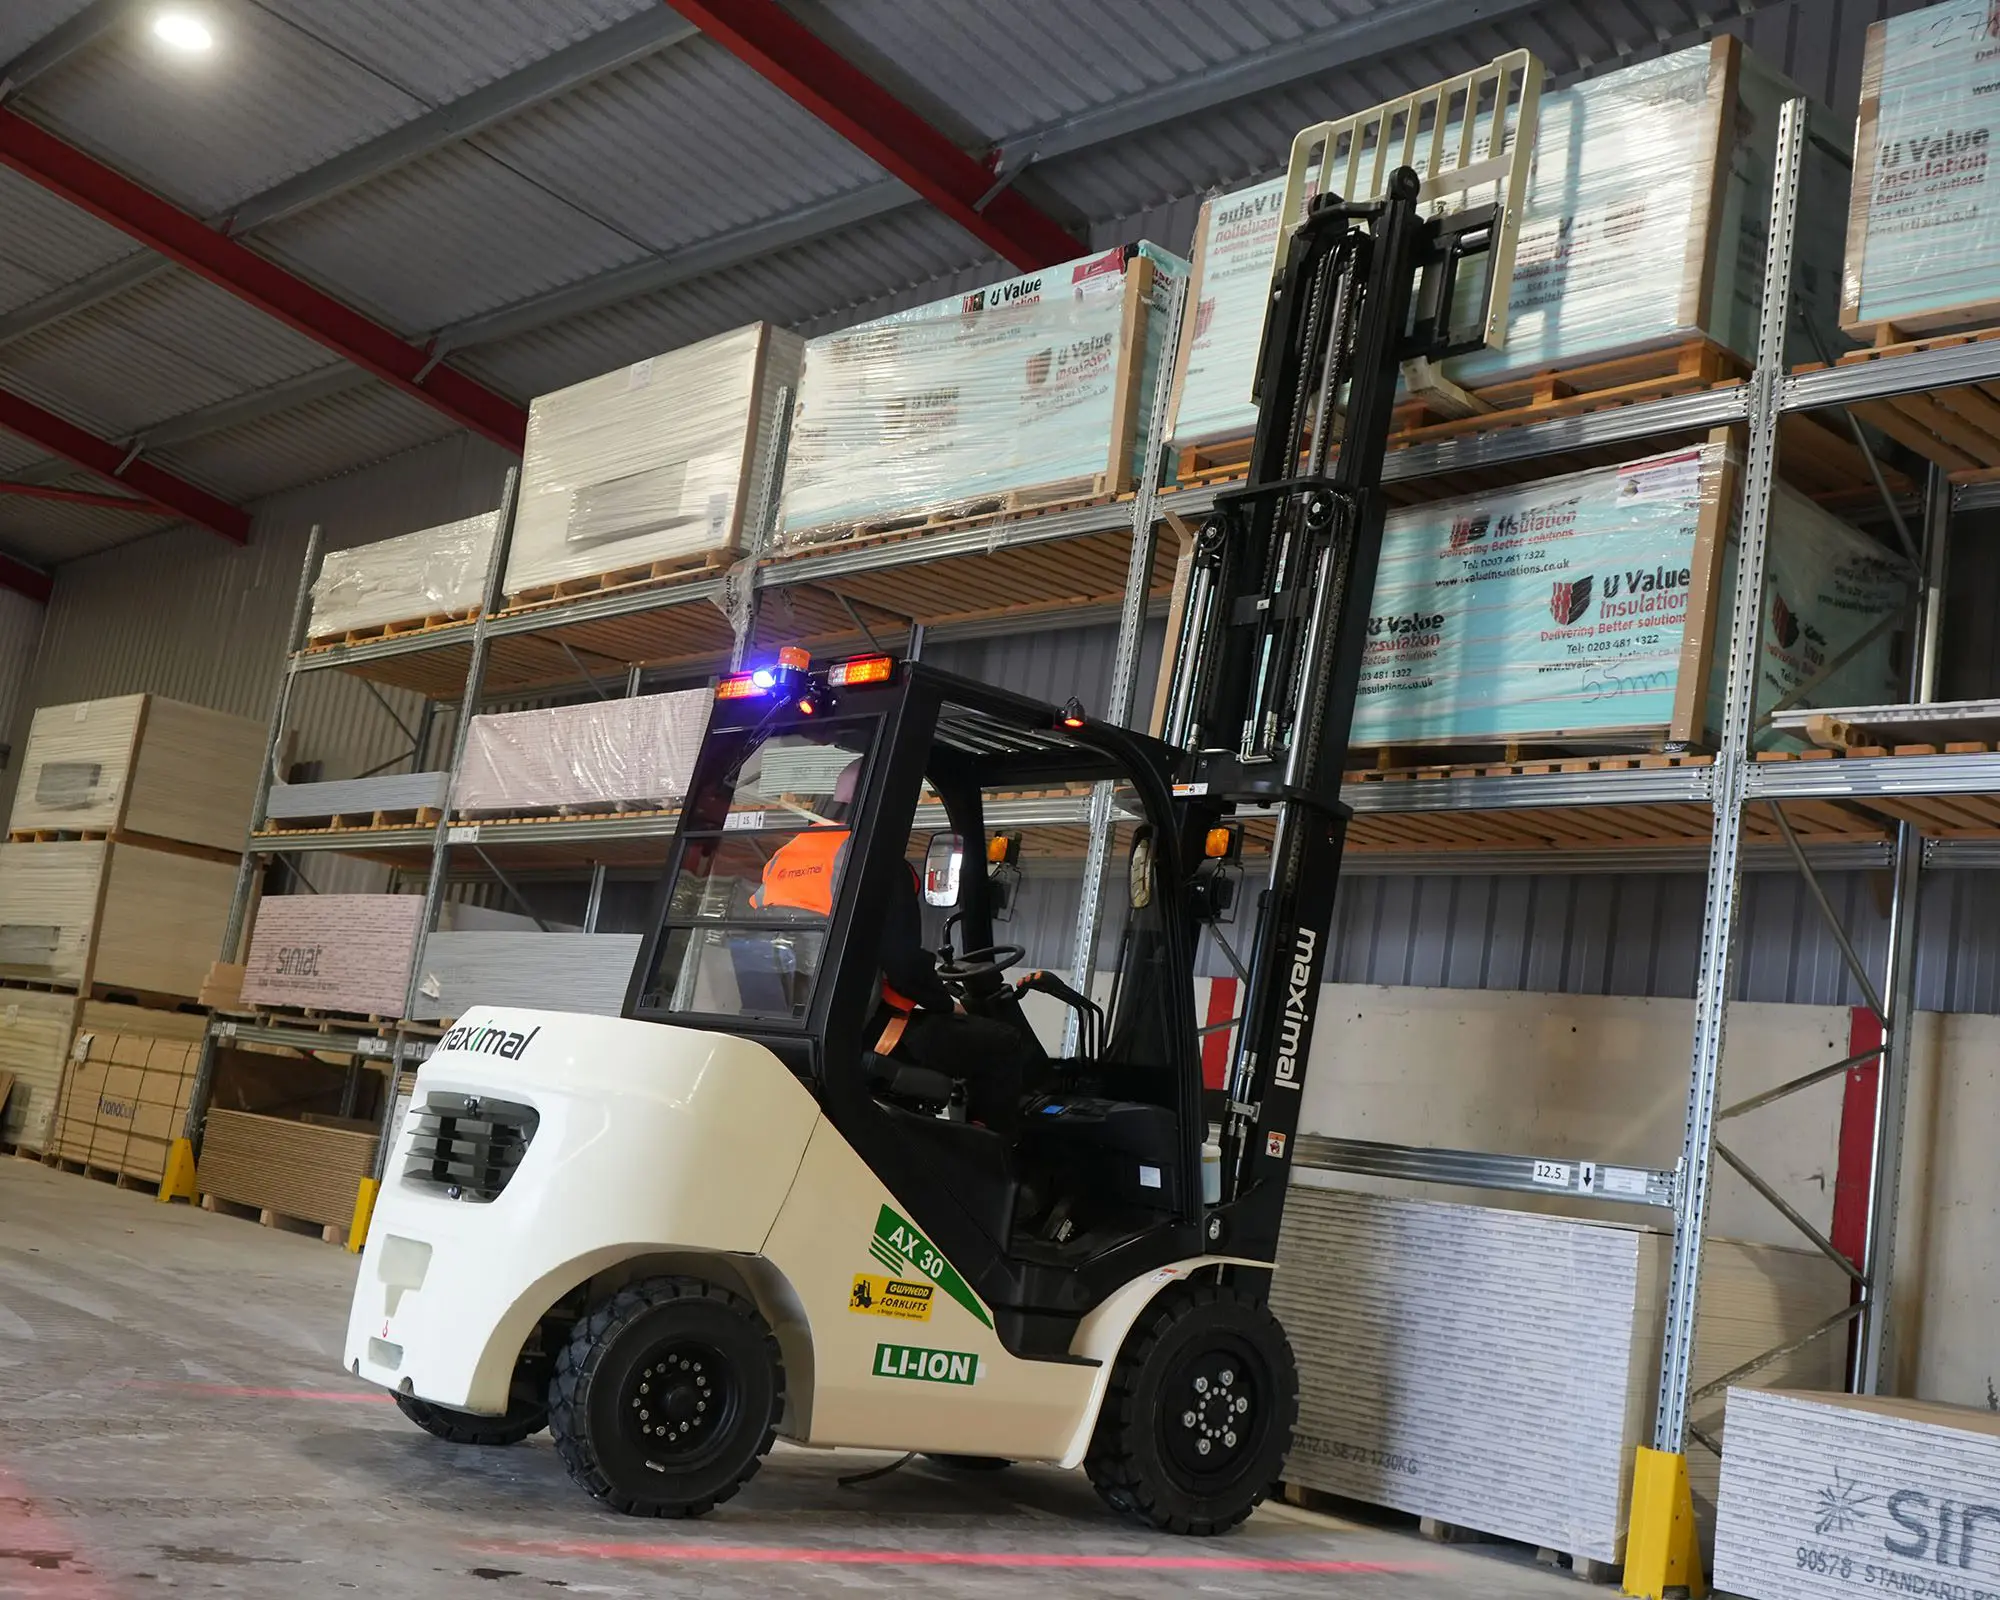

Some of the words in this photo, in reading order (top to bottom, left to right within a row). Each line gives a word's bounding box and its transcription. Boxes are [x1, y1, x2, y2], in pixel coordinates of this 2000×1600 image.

[1908, 128, 1989, 162] Value
[1004, 278, 1042, 301] Value
[1604, 574, 1620, 598] U
[1625, 565, 1690, 594] Value
[1600, 590, 1689, 619] Insulation
[1366, 617, 1382, 635] U
[1387, 612, 1445, 634] Value
[1540, 626, 1595, 643] Delivering
[1598, 620, 1634, 635] Better
[1637, 612, 1687, 628] solutions
[1566, 643, 1585, 655] Tel:
[1587, 640, 1611, 653] 0203
[1612, 637, 1632, 649] 481
[1635, 634, 1660, 646] 1322
[1374, 670, 1388, 680] 481
[1392, 668, 1412, 678] 1322
[788, 863, 823, 878] maximal
[1274, 927, 1316, 1090] maximal
[439, 1020, 541, 1060] maximal
[888, 1225, 920, 1259] AX
[919, 1249, 944, 1279] 30
[880, 1297, 927, 1311] FORKLIFTS
[890, 1284, 930, 1297] GWYNEDD
[880, 1347, 971, 1381] LI-ION
[1796, 1546, 1853, 1578] 90578
